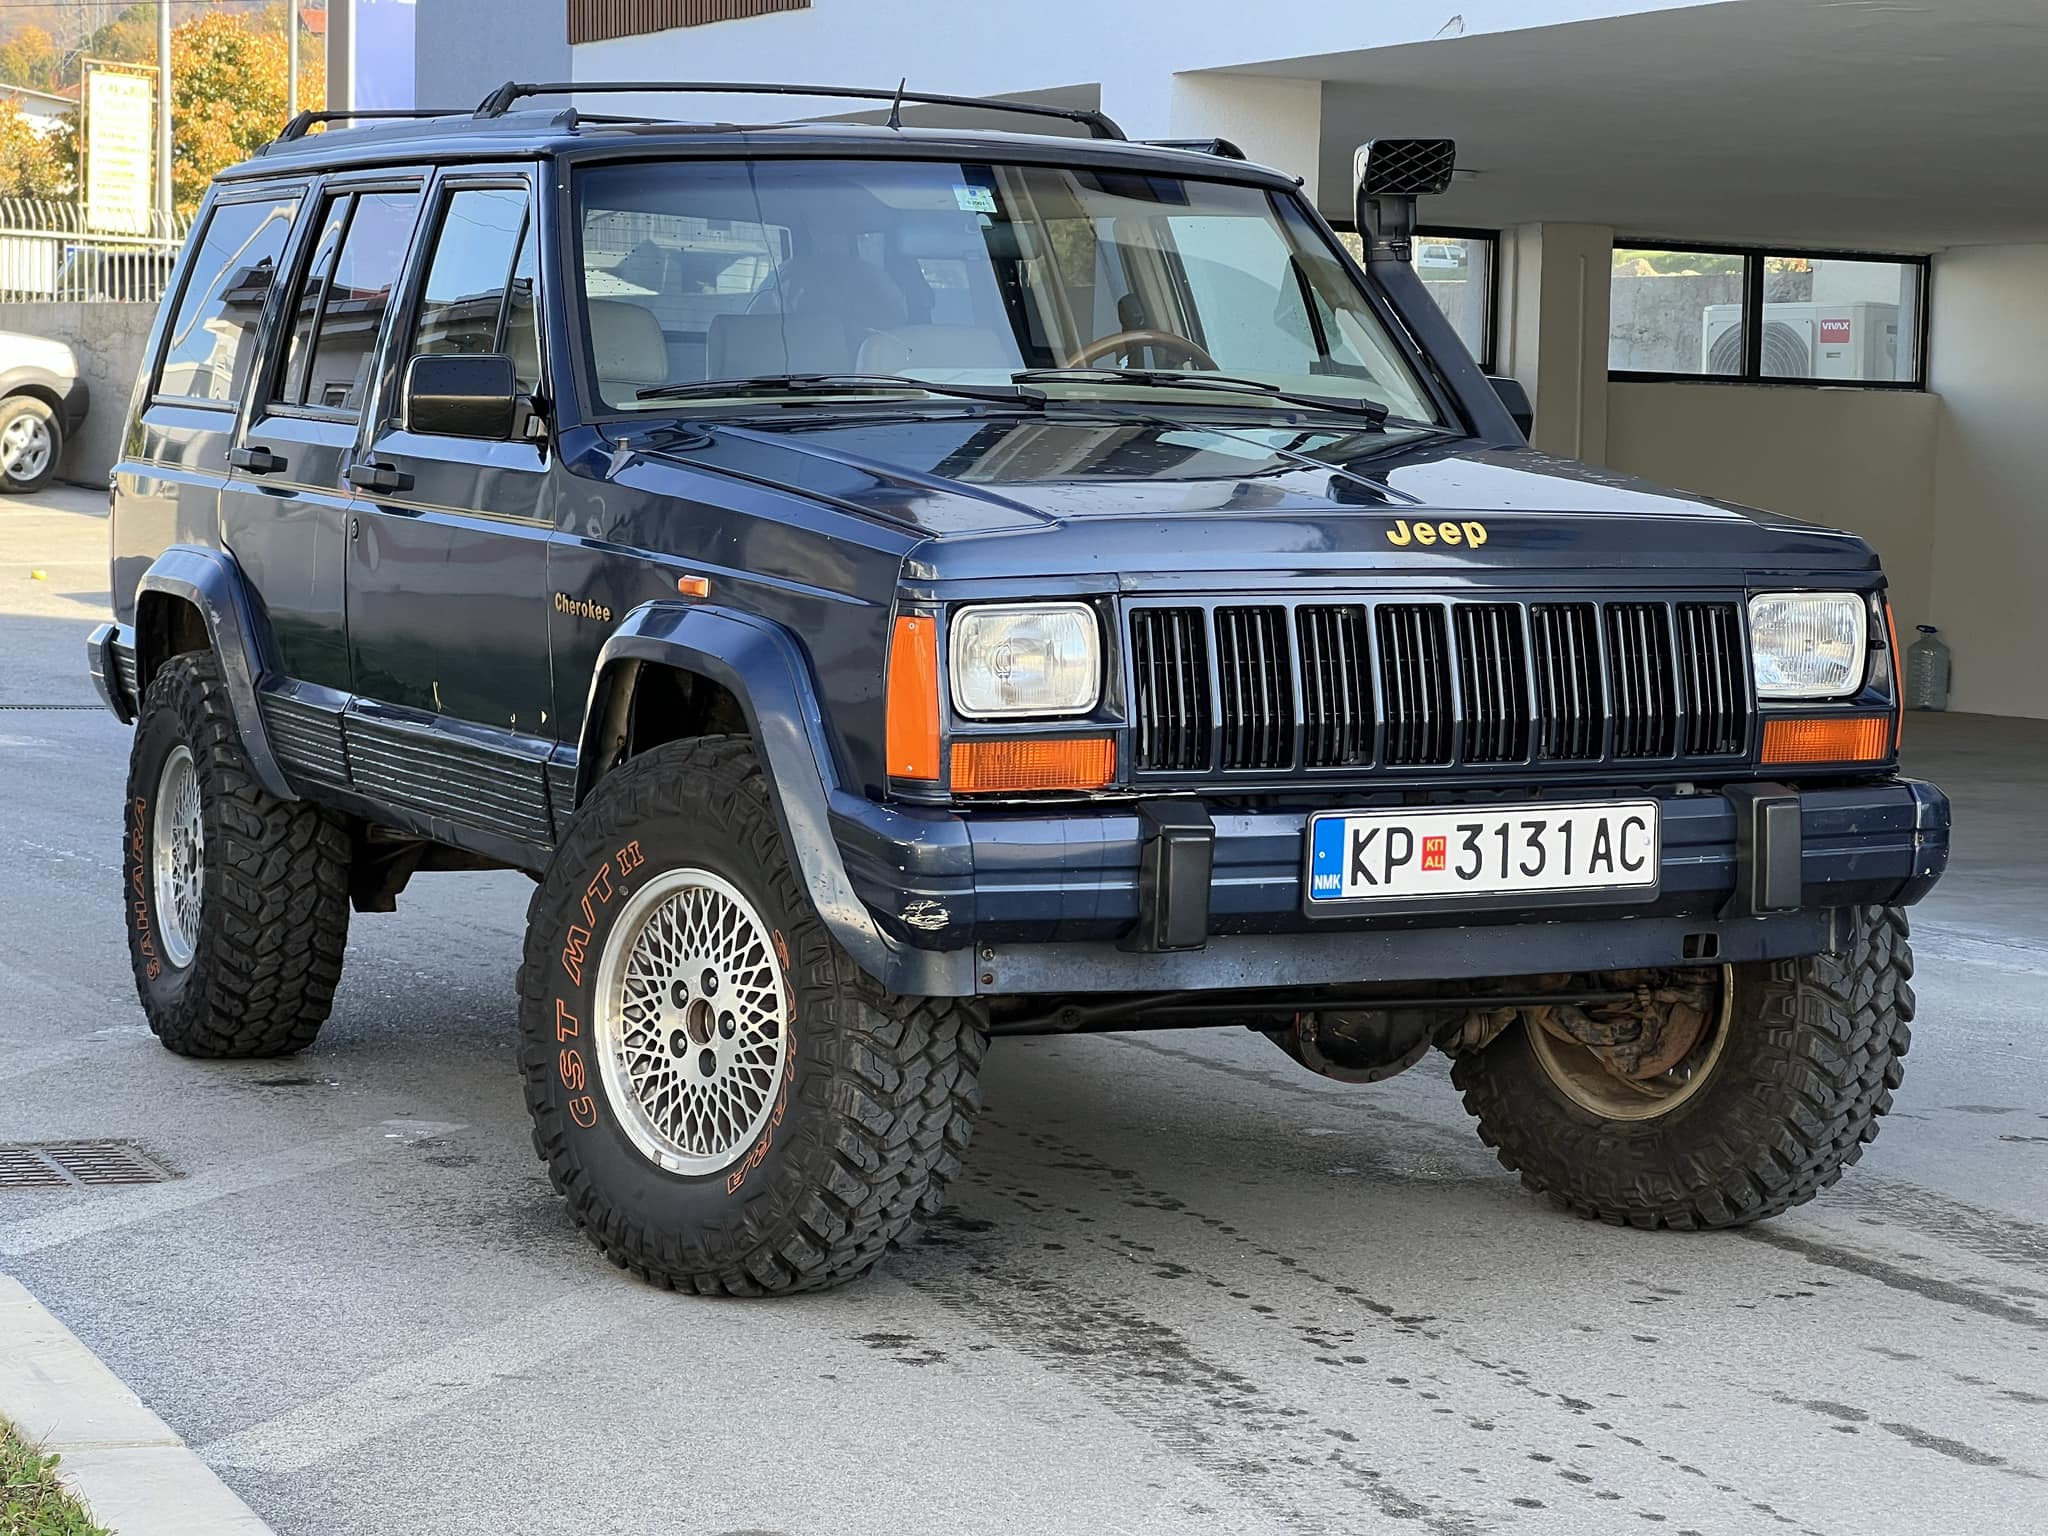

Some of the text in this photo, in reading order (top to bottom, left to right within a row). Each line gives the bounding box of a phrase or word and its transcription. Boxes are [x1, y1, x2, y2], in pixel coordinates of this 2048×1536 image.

[1822, 322, 1849, 330] VIVAX
[1386, 520, 1488, 549] Jeep
[555, 592, 611, 622] Cherokee
[1350, 827, 1414, 886] KP
[132, 797, 161, 981] SAHARA
[1314, 874, 1341, 890] NMK
[556, 998, 597, 1128] CST
